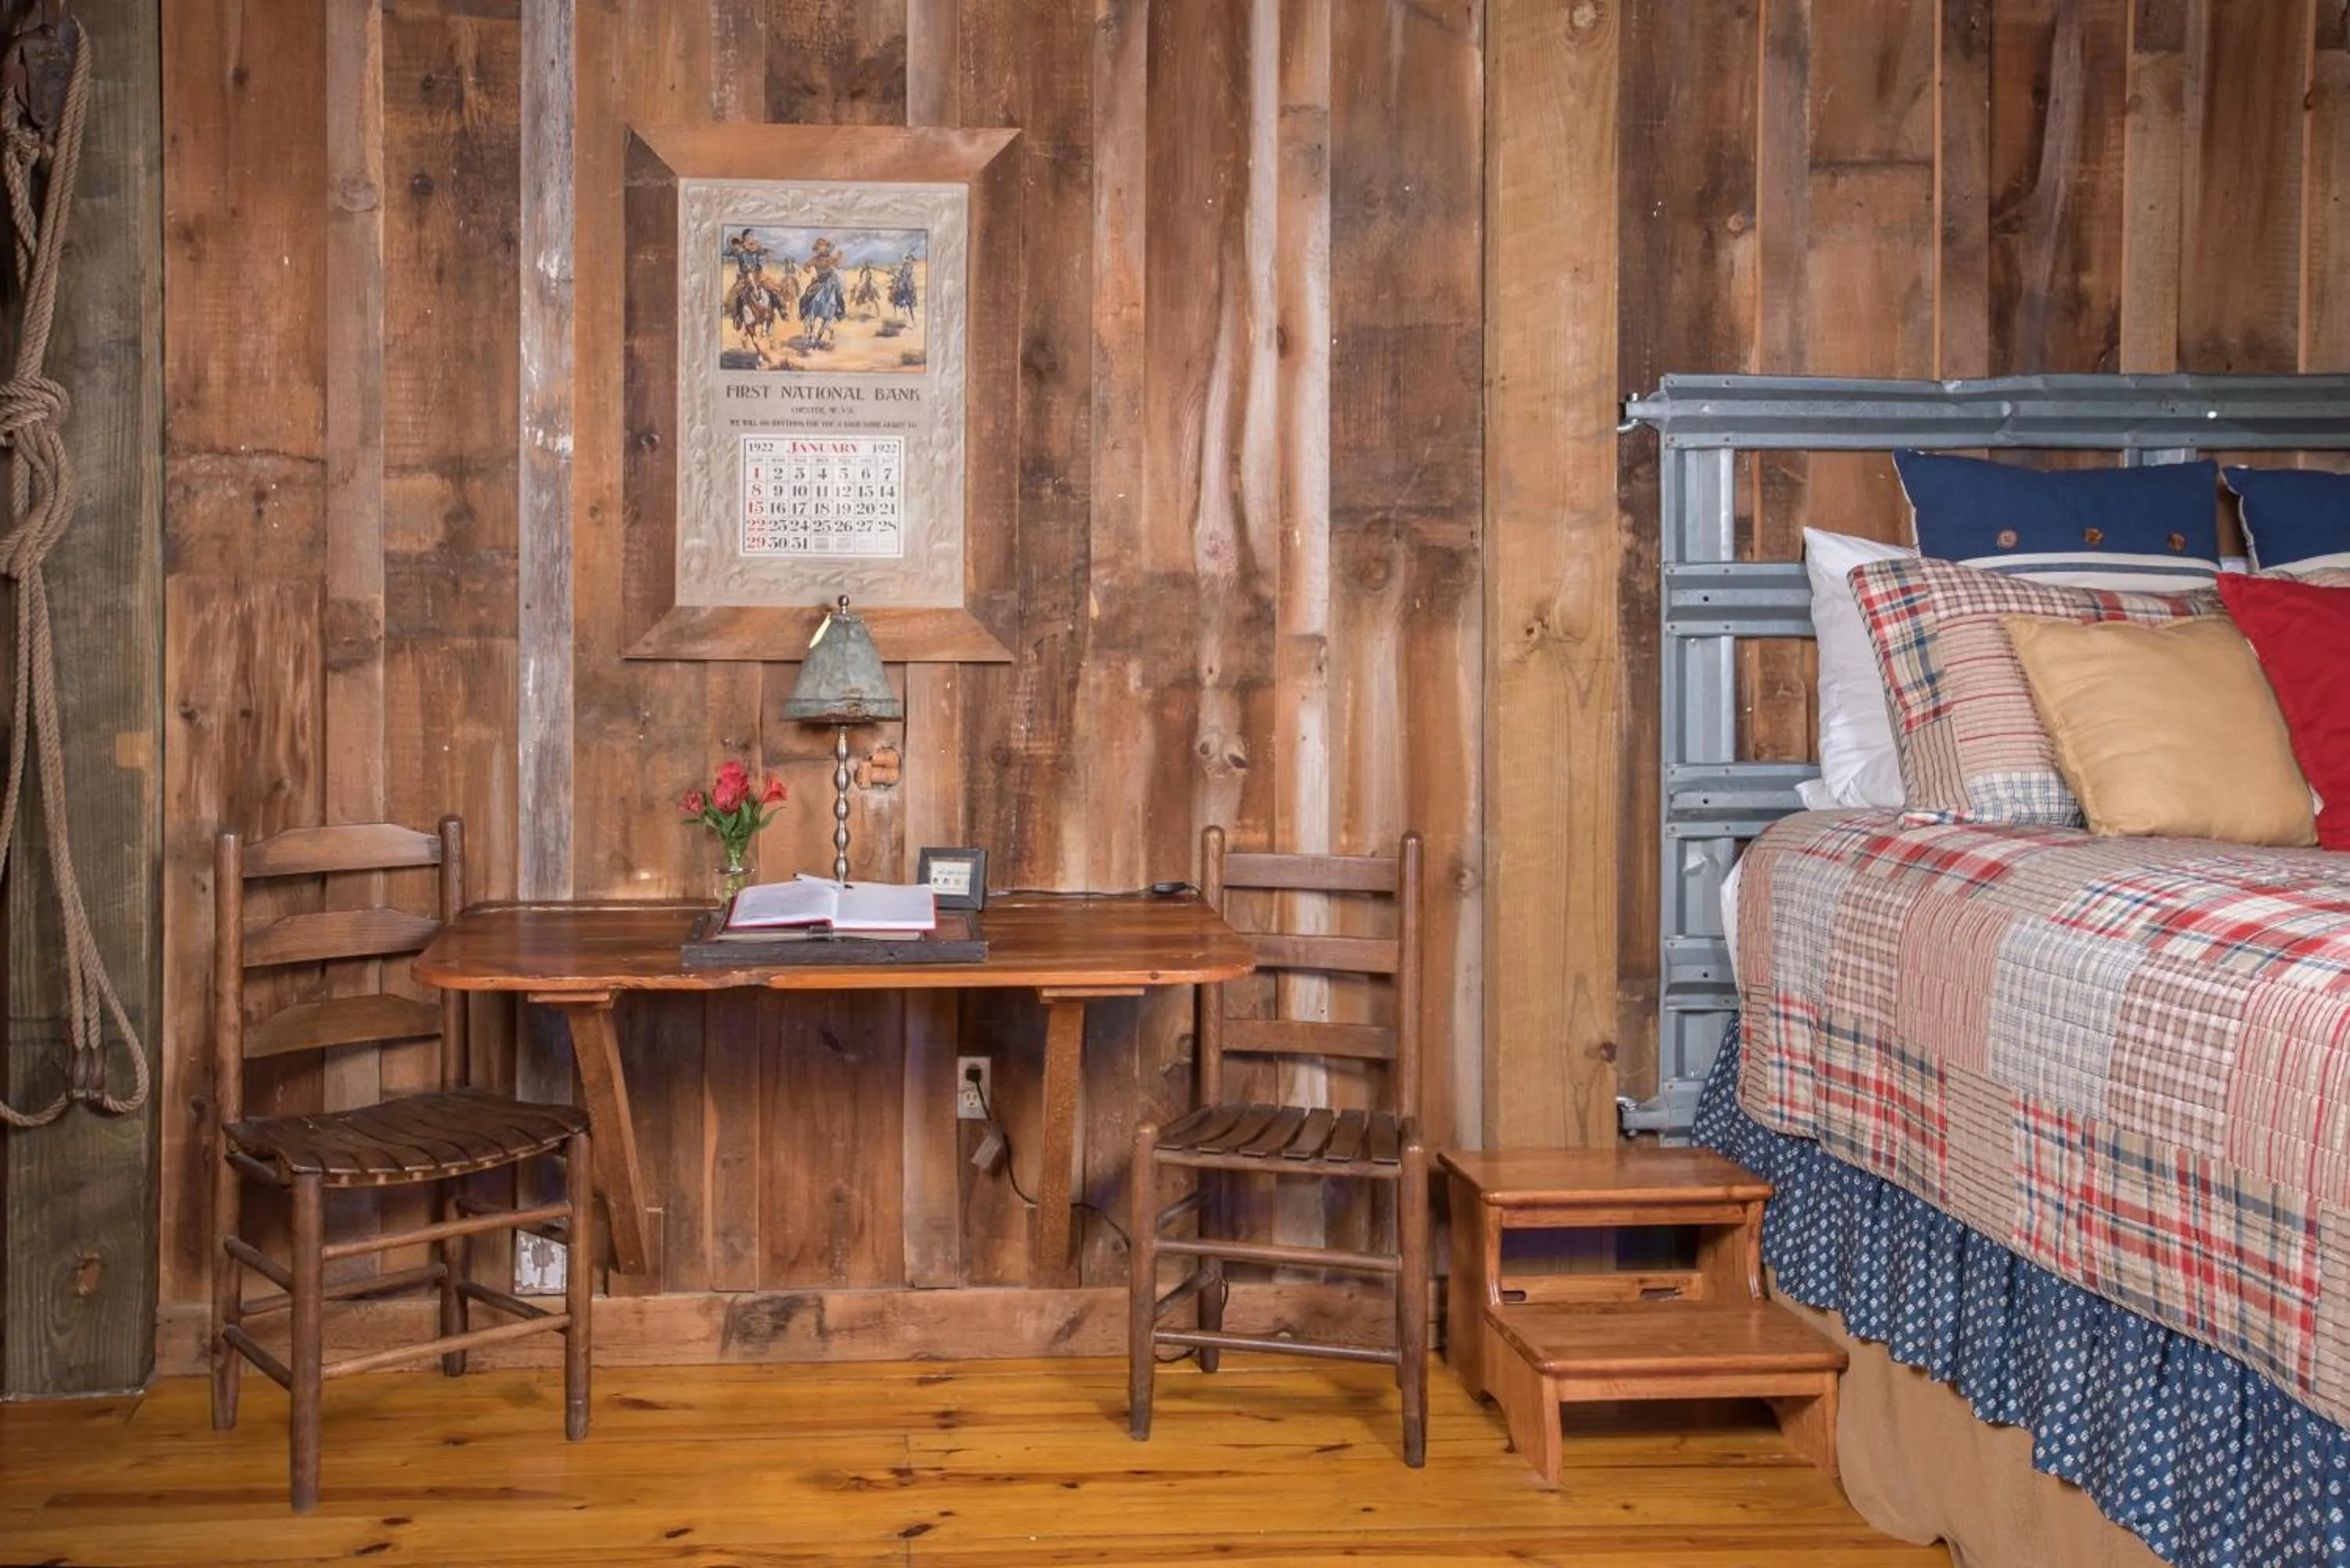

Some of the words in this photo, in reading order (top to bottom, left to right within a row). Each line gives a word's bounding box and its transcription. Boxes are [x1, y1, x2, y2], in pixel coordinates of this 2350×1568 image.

[726, 385, 771, 399] FIRST
[780, 385, 865, 401] NATIONAL
[874, 387, 921, 402] BANK
[749, 443, 774, 453] 1922
[786, 441, 857, 453] JANUARY
[872, 443, 898, 453] 1922
[753, 467, 760, 479] 1
[773, 468, 783, 480] 2
[817, 467, 827, 481] 4
[839, 468, 848, 480] 5
[861, 467, 871, 480] 6
[883, 468, 892, 480] 7
[751, 484, 762, 497] 8
[773, 485, 783, 497] 9
[792, 485, 808, 497] 10
[816, 485, 829, 497] 11
[835, 485, 852, 497] 12
[879, 485, 895, 497] 14
[748, 500, 765, 515] 15
[770, 501, 786, 515] 16
[792, 501, 807, 515] 17
[815, 502, 830, 515] 18
[835, 502, 851, 515] 19
[855, 502, 875, 515] 20
[879, 502, 895, 515] 21
[747, 518, 765, 531] 22
[789, 518, 810, 532] 24
[812, 518, 832, 533] 25
[833, 518, 853, 533] 26
[855, 518, 874, 533] 27
[878, 518, 898, 533] 28
[747, 536, 766, 548] 29
